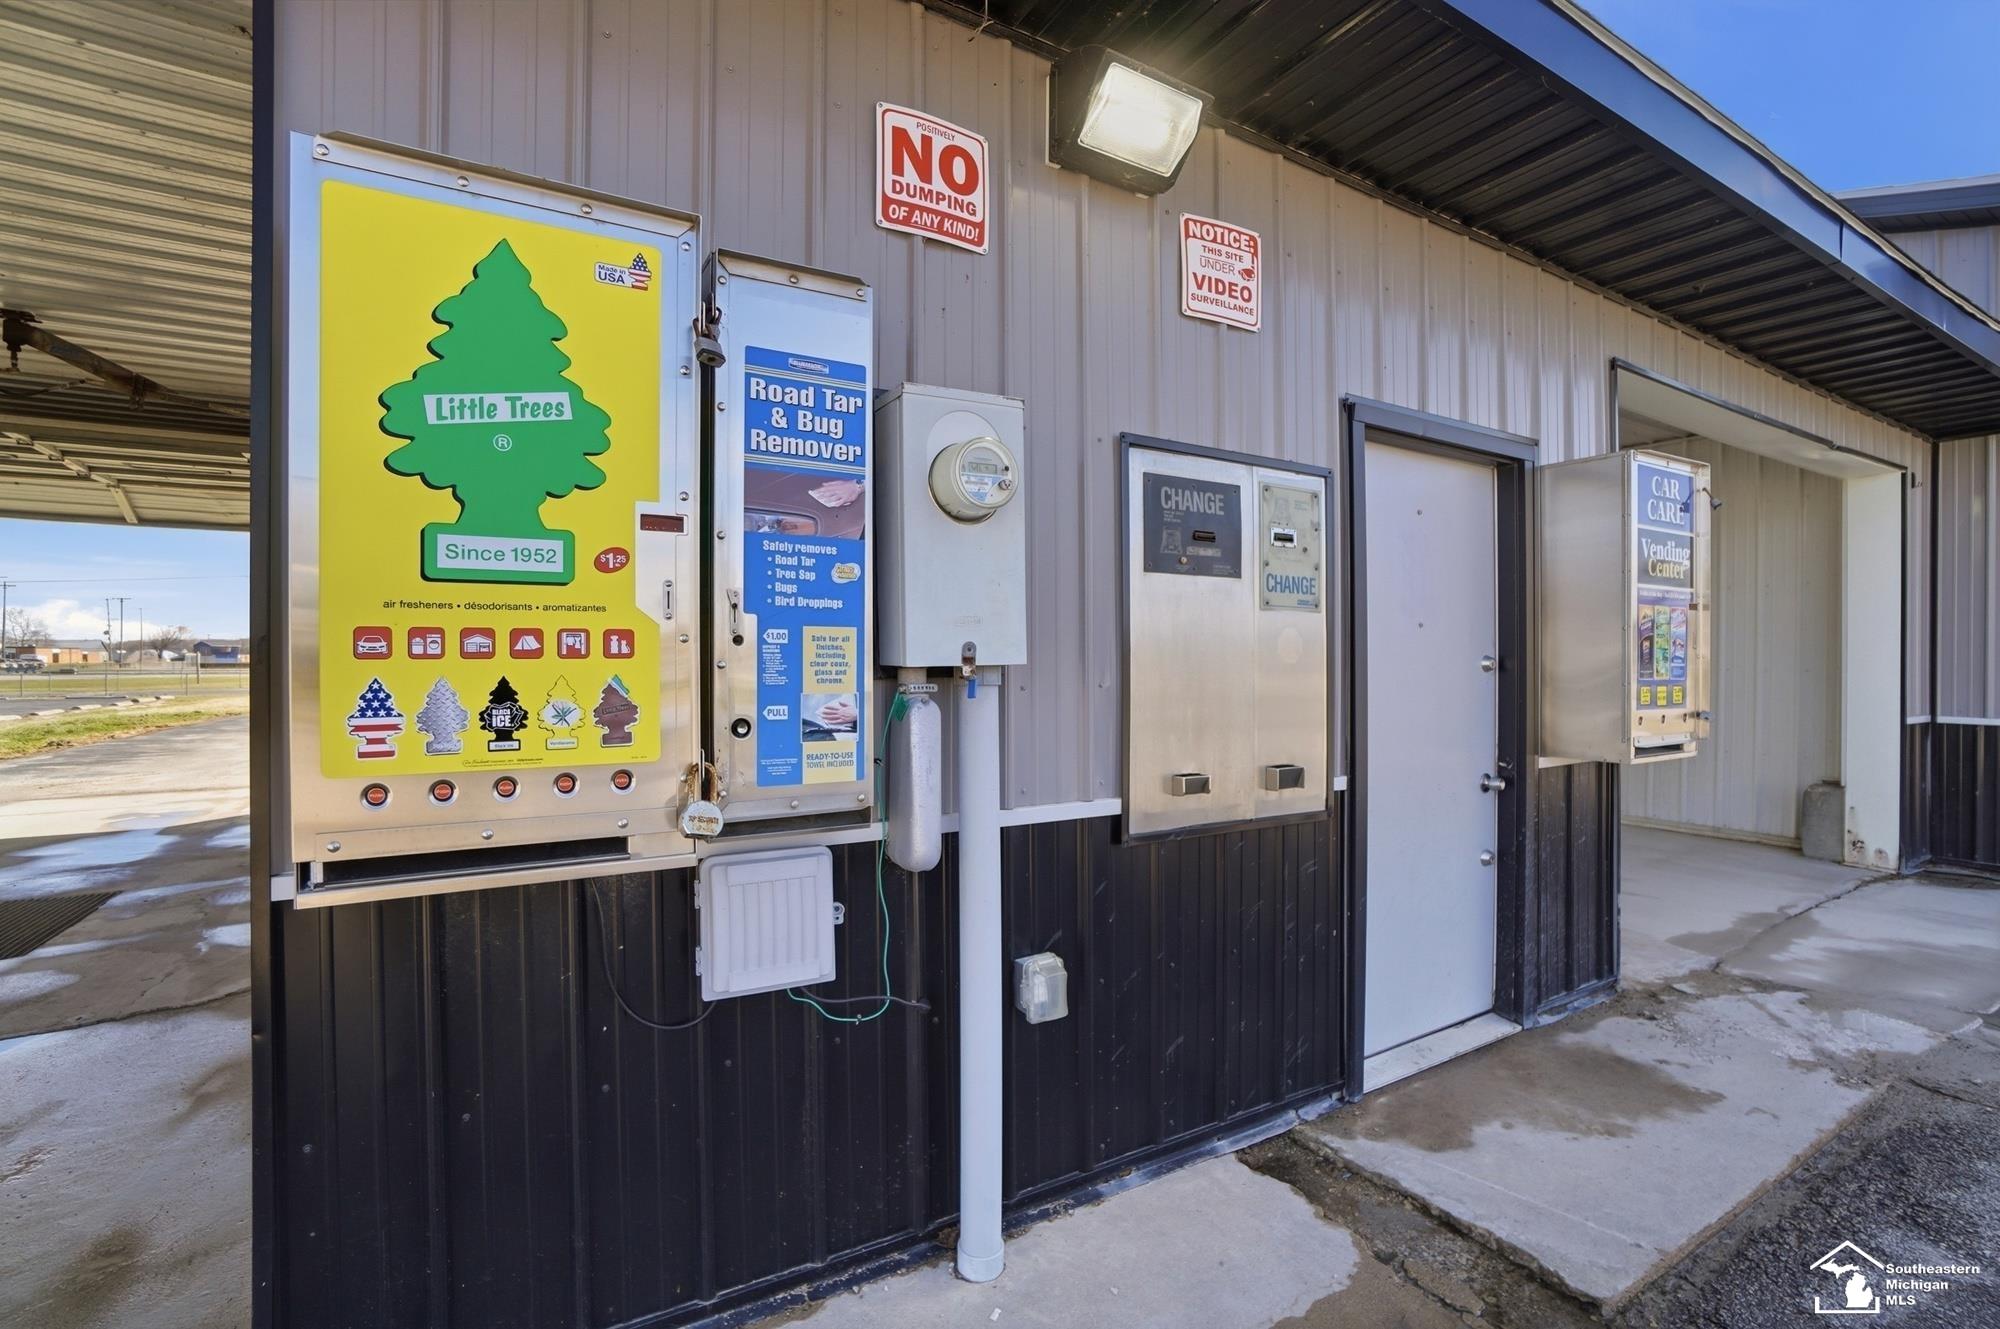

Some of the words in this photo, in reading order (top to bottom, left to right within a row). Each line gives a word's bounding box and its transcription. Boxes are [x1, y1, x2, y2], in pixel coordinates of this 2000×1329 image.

[916, 121, 956, 142] POSITIVELY
[891, 125, 979, 197] NO
[891, 179, 977, 217] DUMPING
[888, 204, 908, 220] OF
[911, 210, 941, 229] ANY
[943, 218, 979, 241] KIND!
[1201, 244, 1223, 257] THIS
[1224, 251, 1244, 264] SITE
[598, 264, 617, 273] Made
[598, 270, 625, 284] USA
[1199, 257, 1236, 276] UNDER
[1192, 272, 1252, 303] VIDEO
[1190, 292, 1254, 316] SURVEILLANCE
[750, 377, 815, 408] Road
[822, 388, 863, 414] Tar
[435, 396, 498, 421] Little
[504, 395, 565, 419] Trees
[771, 407, 788, 429] &
[797, 409, 844, 439] Bug
[750, 428, 862, 462] Remover
[1651, 475, 1681, 500] CAR
[1160, 486, 1225, 516] CHANGE
[1647, 498, 1685, 525] CARE
[444, 543, 505, 562] Since
[511, 547, 557, 564] 1952
[763, 540, 793, 554] Safely
[795, 543, 838, 555] removes
[1640, 537, 1691, 569] Vending
[600, 552, 627, 569] $1.25
[775, 554, 798, 566] Road
[800, 556, 816, 567] Tar
[1648, 558, 1686, 579] Center
[775, 568, 796, 579] Tree
[799, 569, 816, 581] Sap
[1265, 572, 1316, 596] CHANGE
[775, 582, 798, 594] Bugs
[383, 600, 396, 609] air
[399, 599, 454, 610] fresheners
[463, 601, 533, 612] désodorisants
[542, 603, 607, 613] aromatizantes
[775, 596, 795, 606] Bird
[797, 596, 844, 609] Droppings
[766, 632, 787, 641] $1.00
[815, 652, 846, 660] including
[767, 707, 787, 717] PULL
[806, 752, 854, 760] READY-TO-USE
[826, 760, 854, 768] INCLUDED
